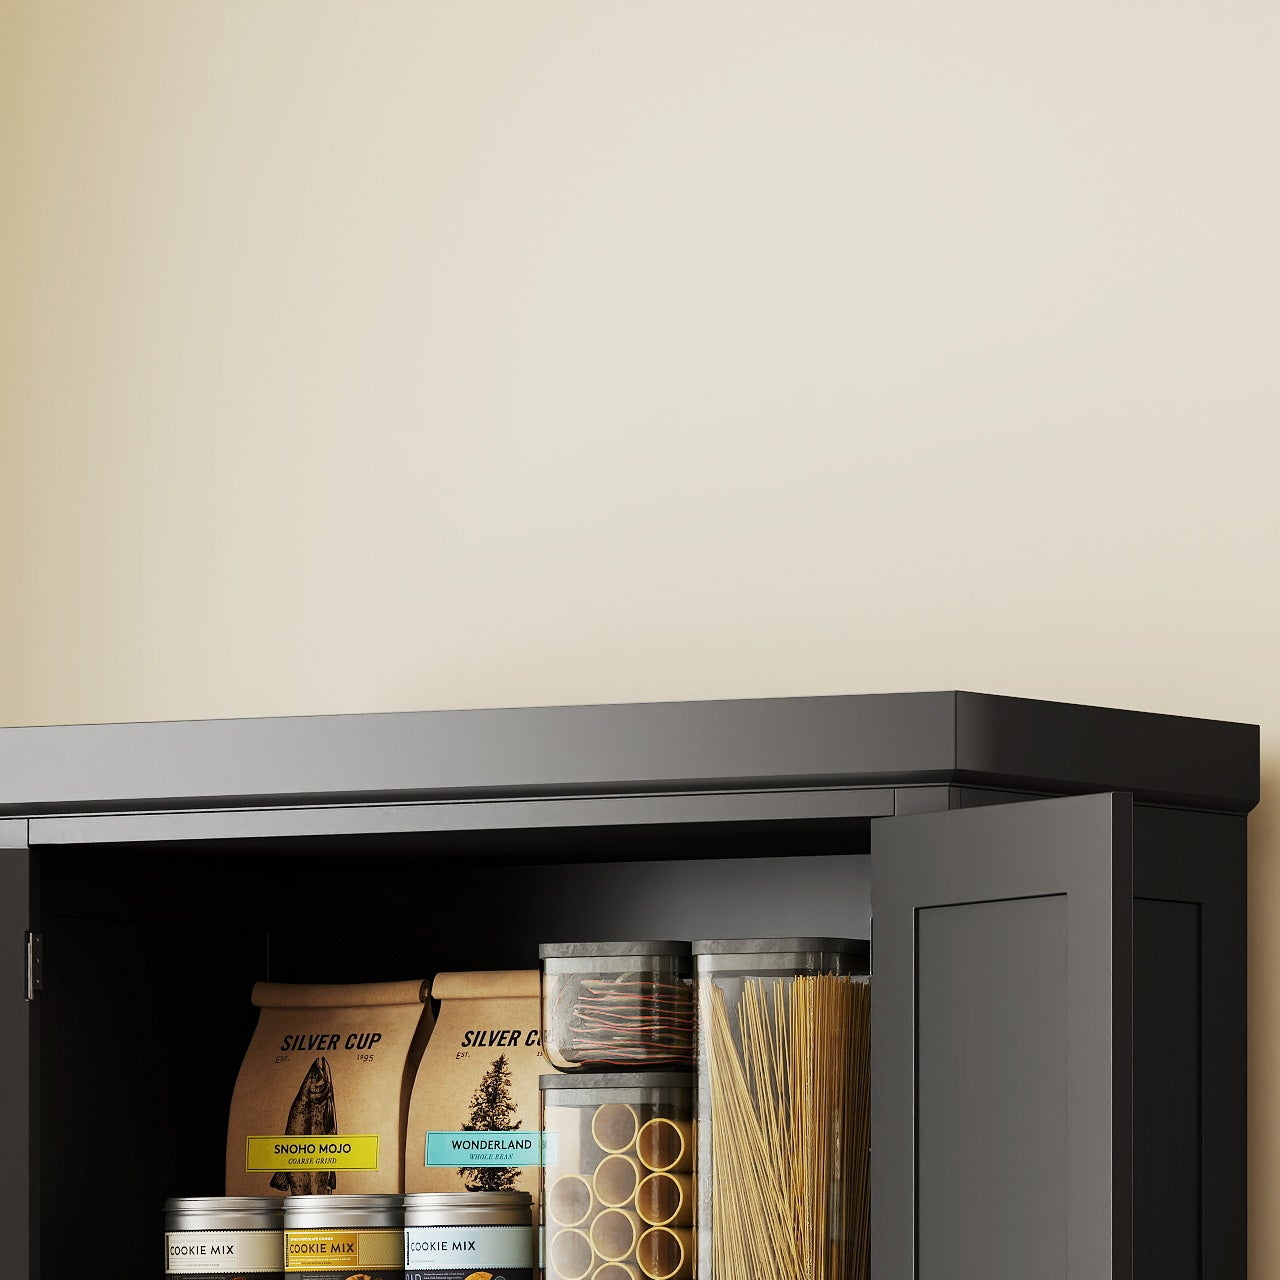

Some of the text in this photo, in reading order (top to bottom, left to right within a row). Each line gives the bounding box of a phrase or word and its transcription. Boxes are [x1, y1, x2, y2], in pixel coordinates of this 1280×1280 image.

[281, 1033, 381, 1051] SILVER CUP
[461, 1030, 521, 1047] SILVER
[357, 1054, 374, 1062] 1995
[274, 1143, 351, 1154] SNOHO MOJO
[452, 1140, 532, 1150] WONDERLAND
[315, 1157, 337, 1165] GRIND
[170, 1245, 234, 1256] COOKIE MIX
[289, 1243, 354, 1254] COOKIE MIX
[411, 1241, 476, 1251] COOKIE MIX
